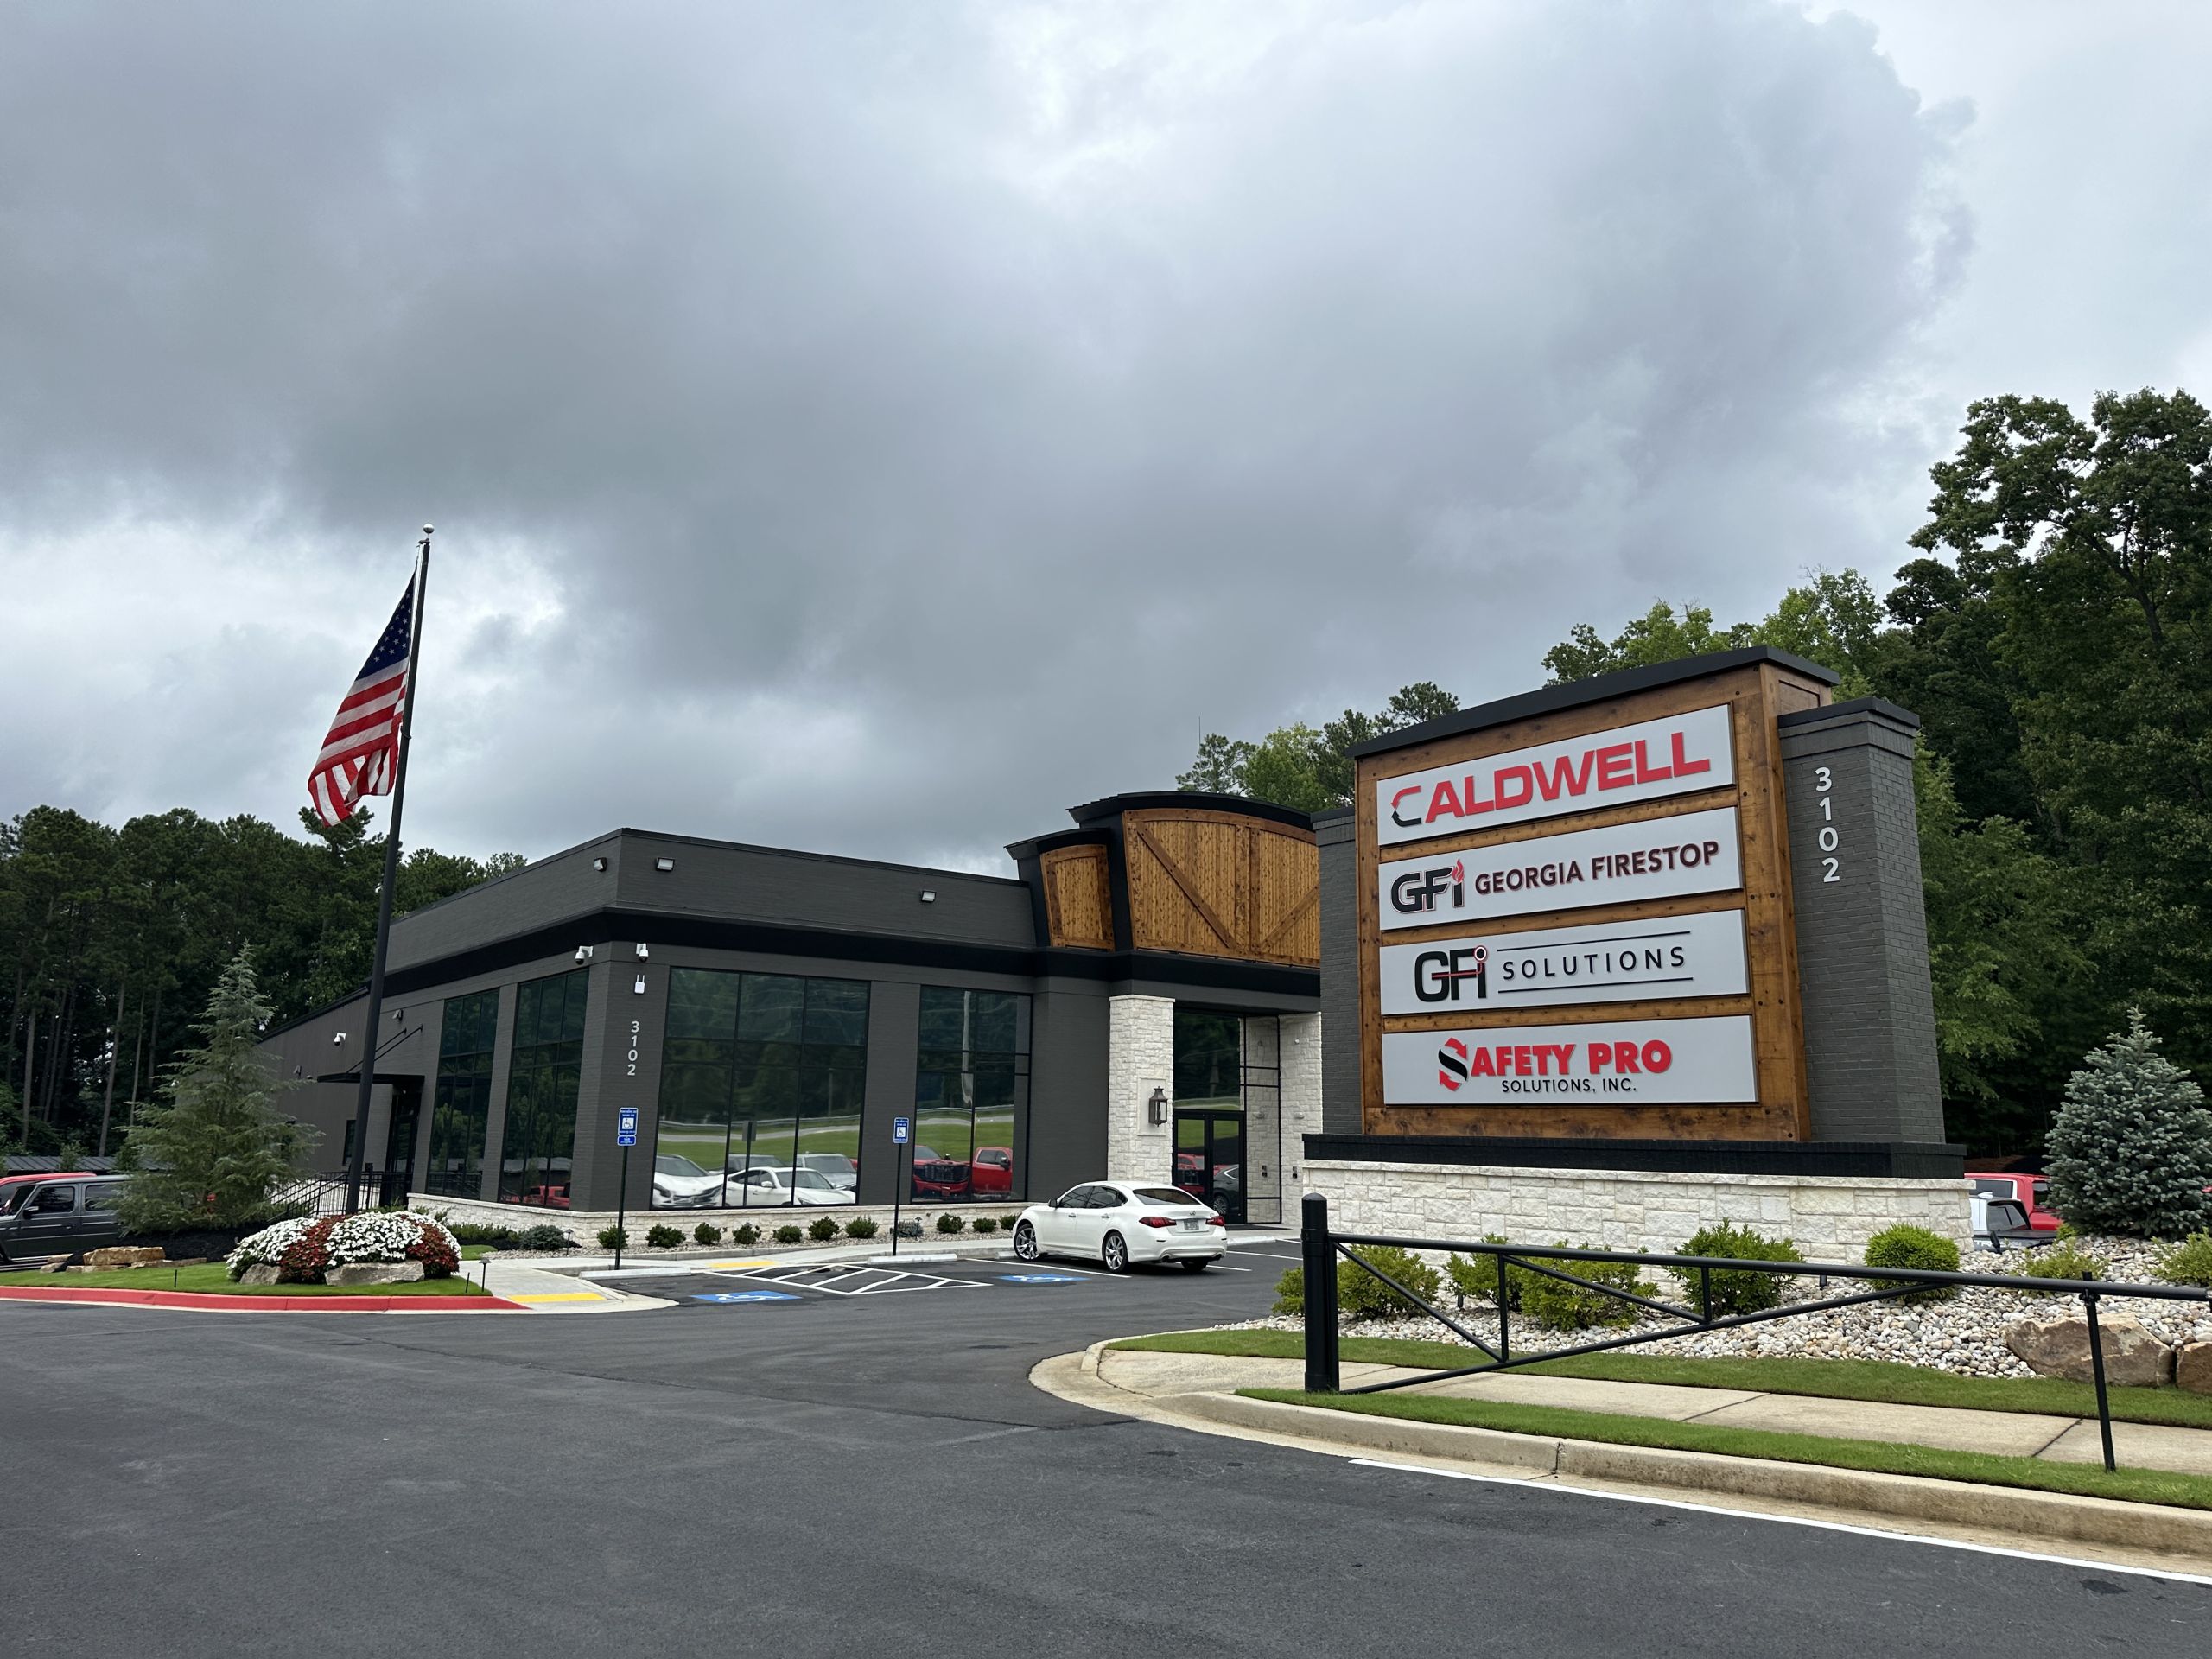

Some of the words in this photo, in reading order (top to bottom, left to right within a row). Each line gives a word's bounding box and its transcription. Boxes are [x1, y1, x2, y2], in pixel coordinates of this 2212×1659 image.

[1391, 731, 1711, 827] CALDWELL
[1815, 766, 1840, 883] 3102
[1474, 860, 1584, 895] GEORGIA
[1591, 841, 1720, 880] FIRESTOP
[1503, 946, 1685, 980] SOLUTIONS
[627, 1020, 639, 1076] 3102
[1438, 1037, 1576, 1092] SAFETY
[1588, 1039, 1672, 1074] PRO
[1502, 1078, 1597, 1093] SOLUTIONS,
[1603, 1077, 1637, 1092] INC.
